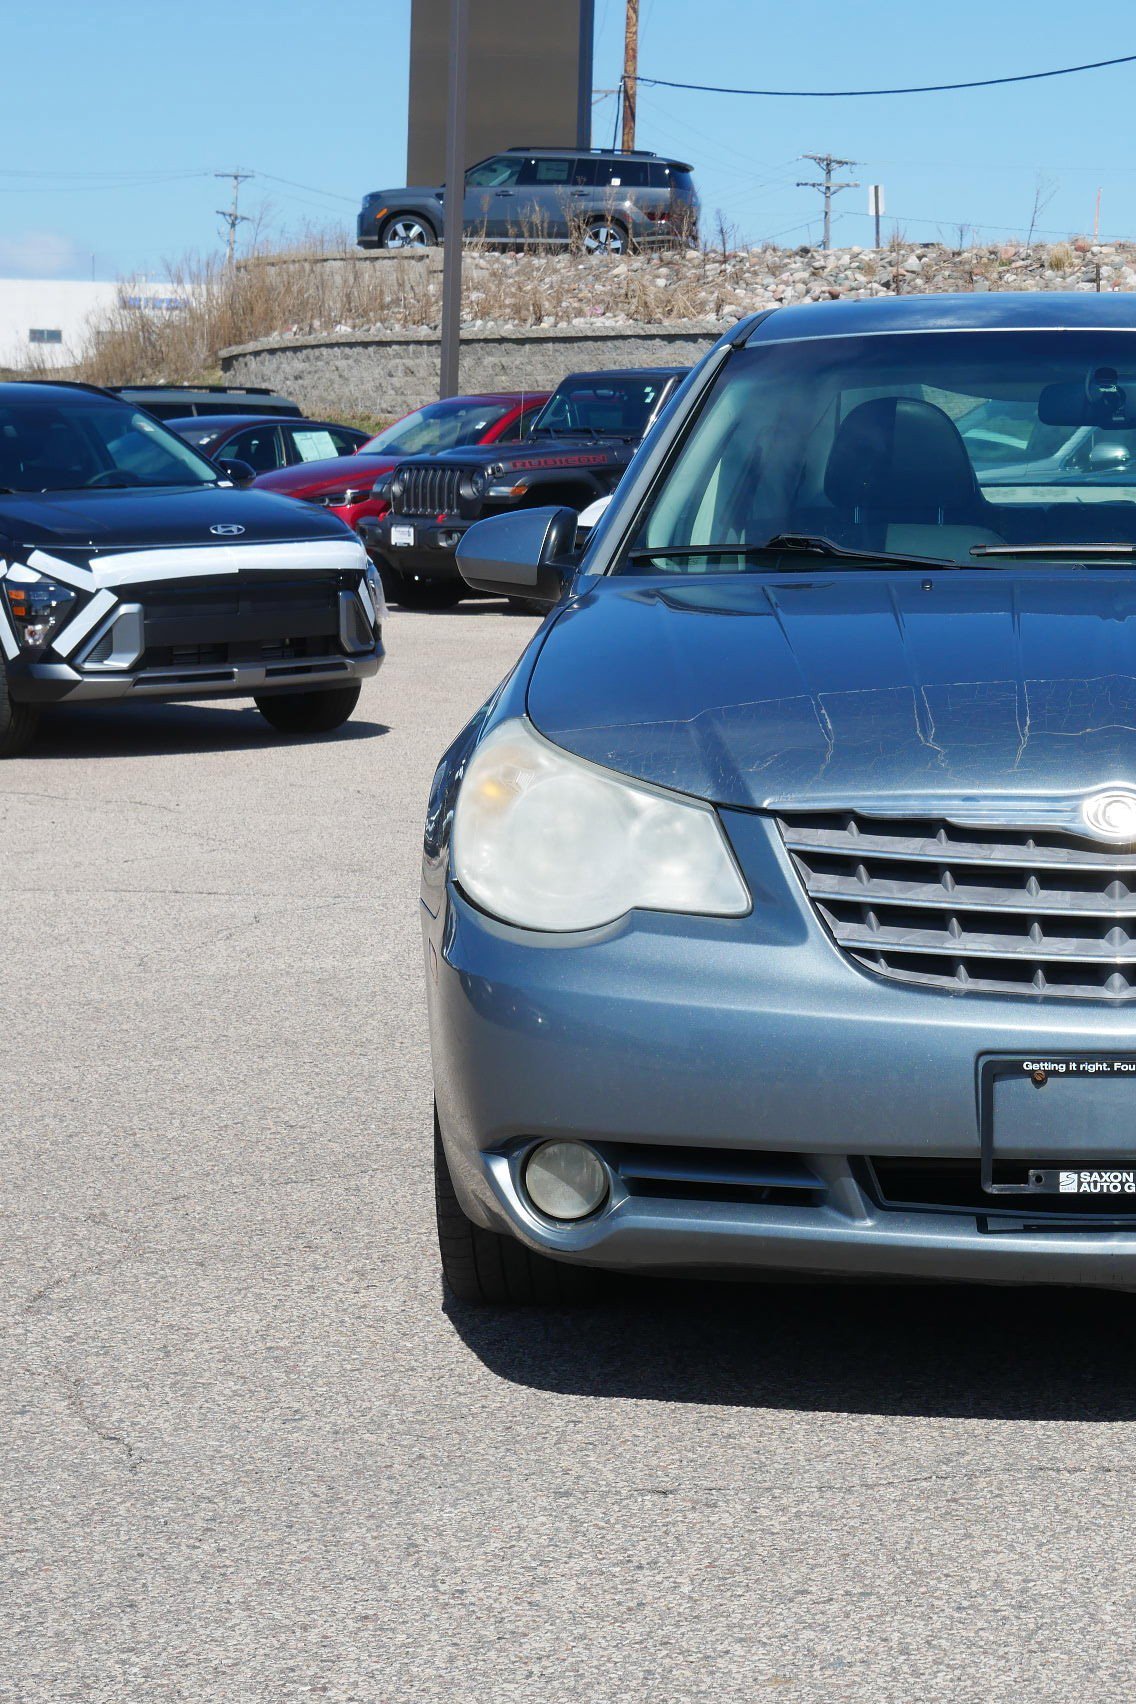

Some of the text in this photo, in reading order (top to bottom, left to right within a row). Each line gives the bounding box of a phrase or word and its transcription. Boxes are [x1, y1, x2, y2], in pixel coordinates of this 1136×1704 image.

[509, 454, 608, 470] RUBICON
[1022, 1061, 1066, 1073] Getting
[1069, 1062, 1077, 1071] it
[1080, 1062, 1111, 1073] right.
[1080, 1172, 1134, 1183] SAXON
[1080, 1182, 1121, 1193] AUTO
